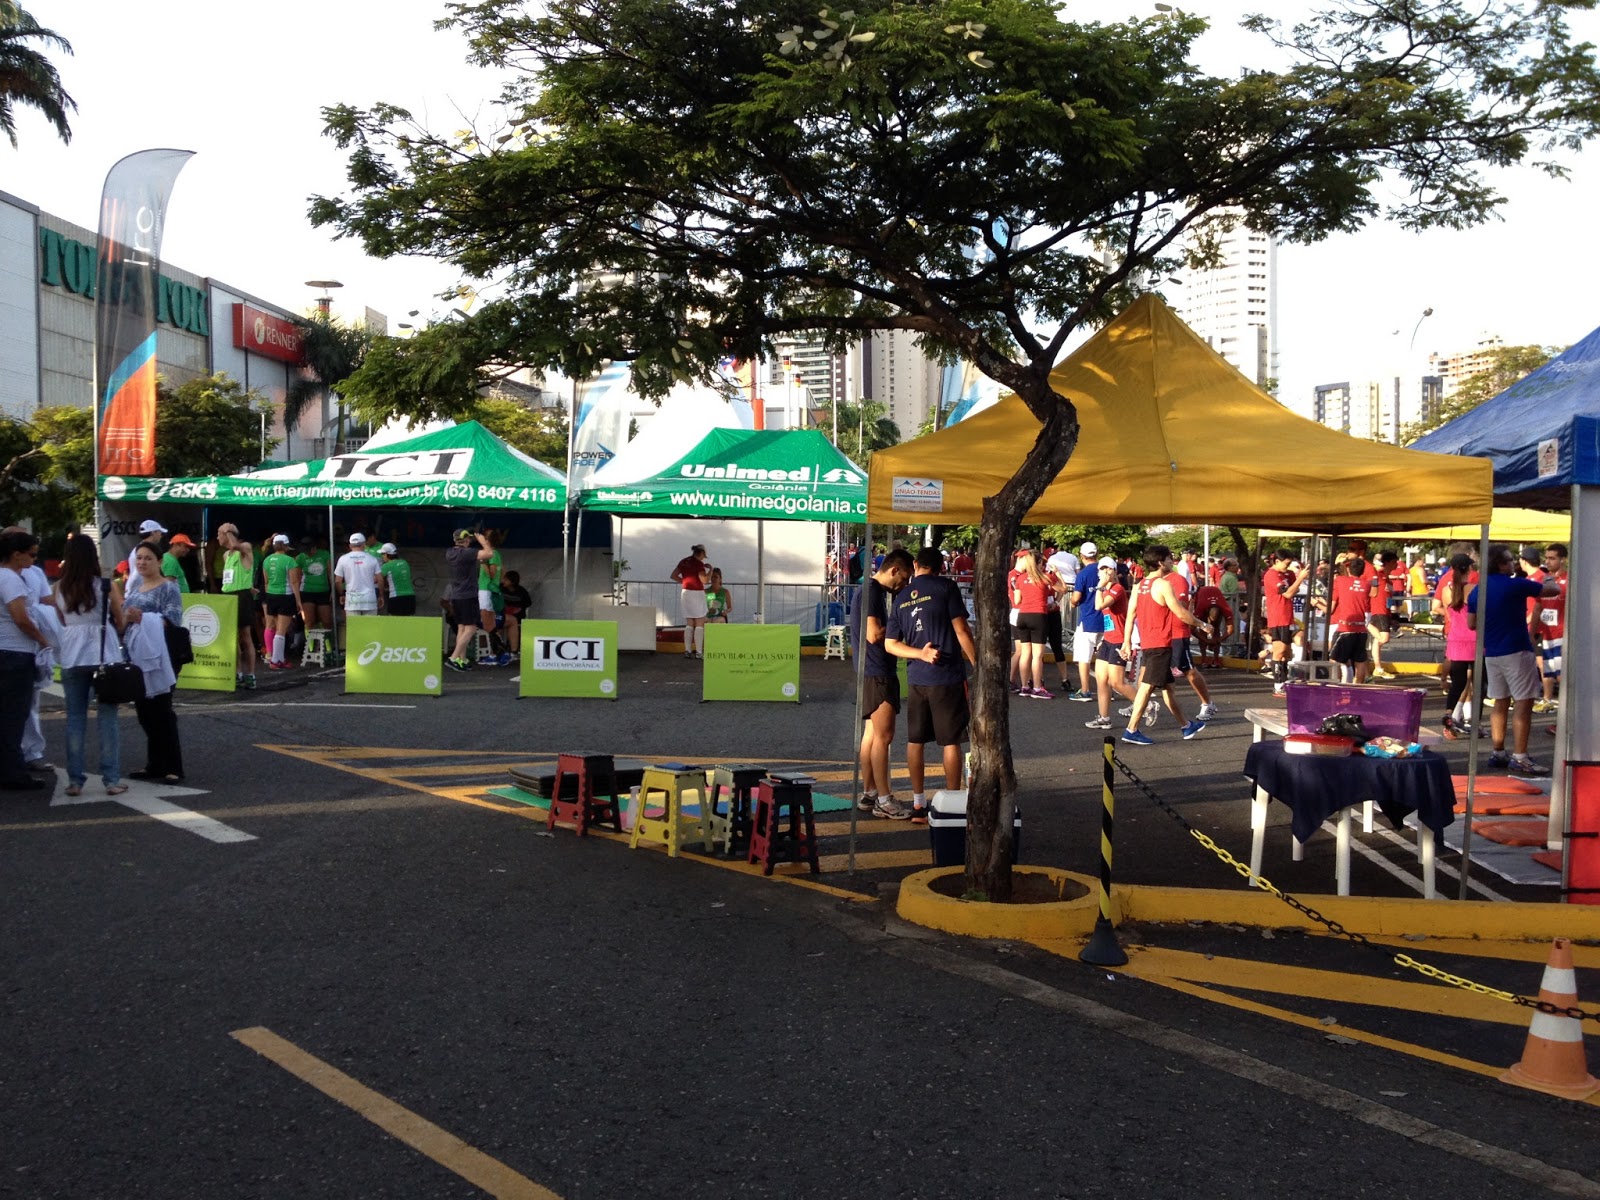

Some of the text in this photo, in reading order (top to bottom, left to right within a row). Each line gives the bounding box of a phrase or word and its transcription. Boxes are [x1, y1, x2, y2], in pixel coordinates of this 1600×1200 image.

[266, 326, 297, 352] RENNER
[573, 451, 612, 459] POWER
[680, 463, 811, 481] Unimed
[233, 483, 557, 502] www.therunningclub.com.br (62) 8407 4116
[748, 483, 808, 491] Goiânia
[670, 492, 867, 514] www.unimedgoiania.c
[380, 647, 427, 663] asics
[537, 639, 601, 661] TCI
[537, 661, 601, 669] CONTEMPORÂNEA
